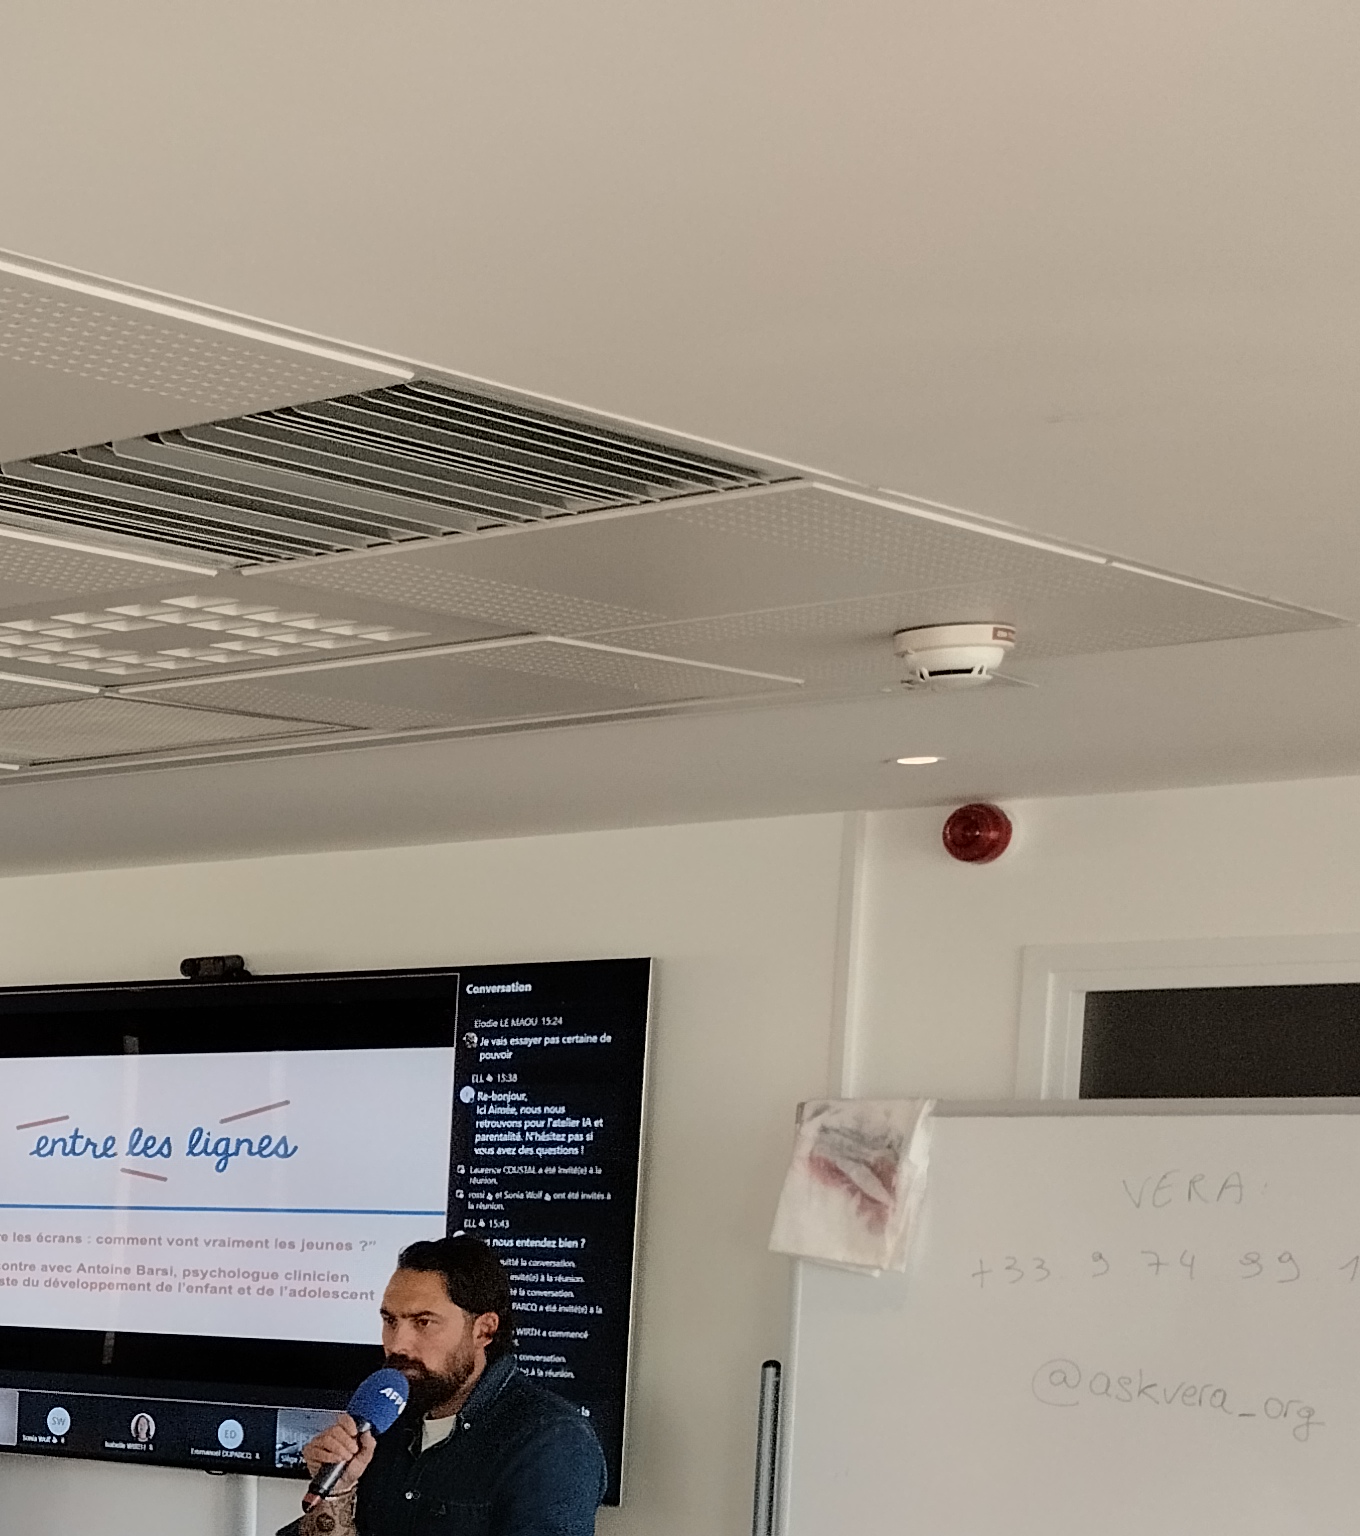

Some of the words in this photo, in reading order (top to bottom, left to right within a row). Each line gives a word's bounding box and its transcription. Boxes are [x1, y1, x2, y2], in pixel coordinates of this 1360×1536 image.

[466, 981, 532, 994] Conversation
[500, 1018, 509, 1027] LE
[541, 1016, 563, 1025] 15:24
[480, 1036, 489, 1046] Je
[491, 1036, 508, 1046] vais
[510, 1036, 542, 1047] essayer
[544, 1035, 560, 1046] pas
[561, 1033, 598, 1044] certaine
[599, 1031, 612, 1043] de
[479, 1050, 513, 1062] pouvoir
[497, 1073, 518, 1083] 15:38
[477, 1091, 528, 1103] Re-bonjour,
[476, 1105, 486, 1115] Ici
[520, 1105, 542, 1114] nous
[543, 1105, 566, 1114] nous
[476, 1118, 522, 1128] retrouvons
[524, 1119, 546, 1130] pour
[593, 1118, 604, 1127] et
[568, 1132, 584, 1143] pas
[585, 1131, 594, 1141] si
[29, 1127, 118, 1158] entre
[125, 1127, 173, 1158] les
[185, 1126, 299, 1173] lignes
[474, 1146, 495, 1155] vous
[496, 1146, 516, 1155] avez
[518, 1145, 534, 1155] des
[536, 1145, 579, 1158] questions
[553, 1191, 566, 1199] ont
[1123, 1170, 1243, 1208] VERA
[489, 1219, 510, 1229] 15:43
[12, 1231, 32, 1242] les
[36, 1232, 82, 1244] écrans
[95, 1234, 163, 1246] comment
[166, 1236, 199, 1248] vont
[203, 1237, 270, 1250] vraiment
[274, 1238, 296, 1250] les
[299, 1238, 353, 1253] jeunes
[492, 1238, 514, 1247] nous
[516, 1237, 557, 1248] entendez
[558, 1238, 579, 1248] bien
[580, 1238, 586, 1248] ?
[40, 1262, 72, 1273] avec
[76, 1263, 131, 1275] Antoine
[136, 1264, 177, 1278] Barsi,
[182, 1266, 279, 1282] psychologue
[284, 1269, 350, 1283] clinicien
[22, 1276, 39, 1288] du
[43, 1277, 151, 1293] développement
[155, 1281, 173, 1293] de
[177, 1282, 233, 1296] l'enfant
[237, 1284, 252, 1296] et
[256, 1284, 274, 1297] de
[279, 1285, 375, 1301] l'adolescent
[1032, 1358, 1326, 1442] @askvera_org
[51, 1417, 66, 1426] SW
[224, 1430, 237, 1439] ED
